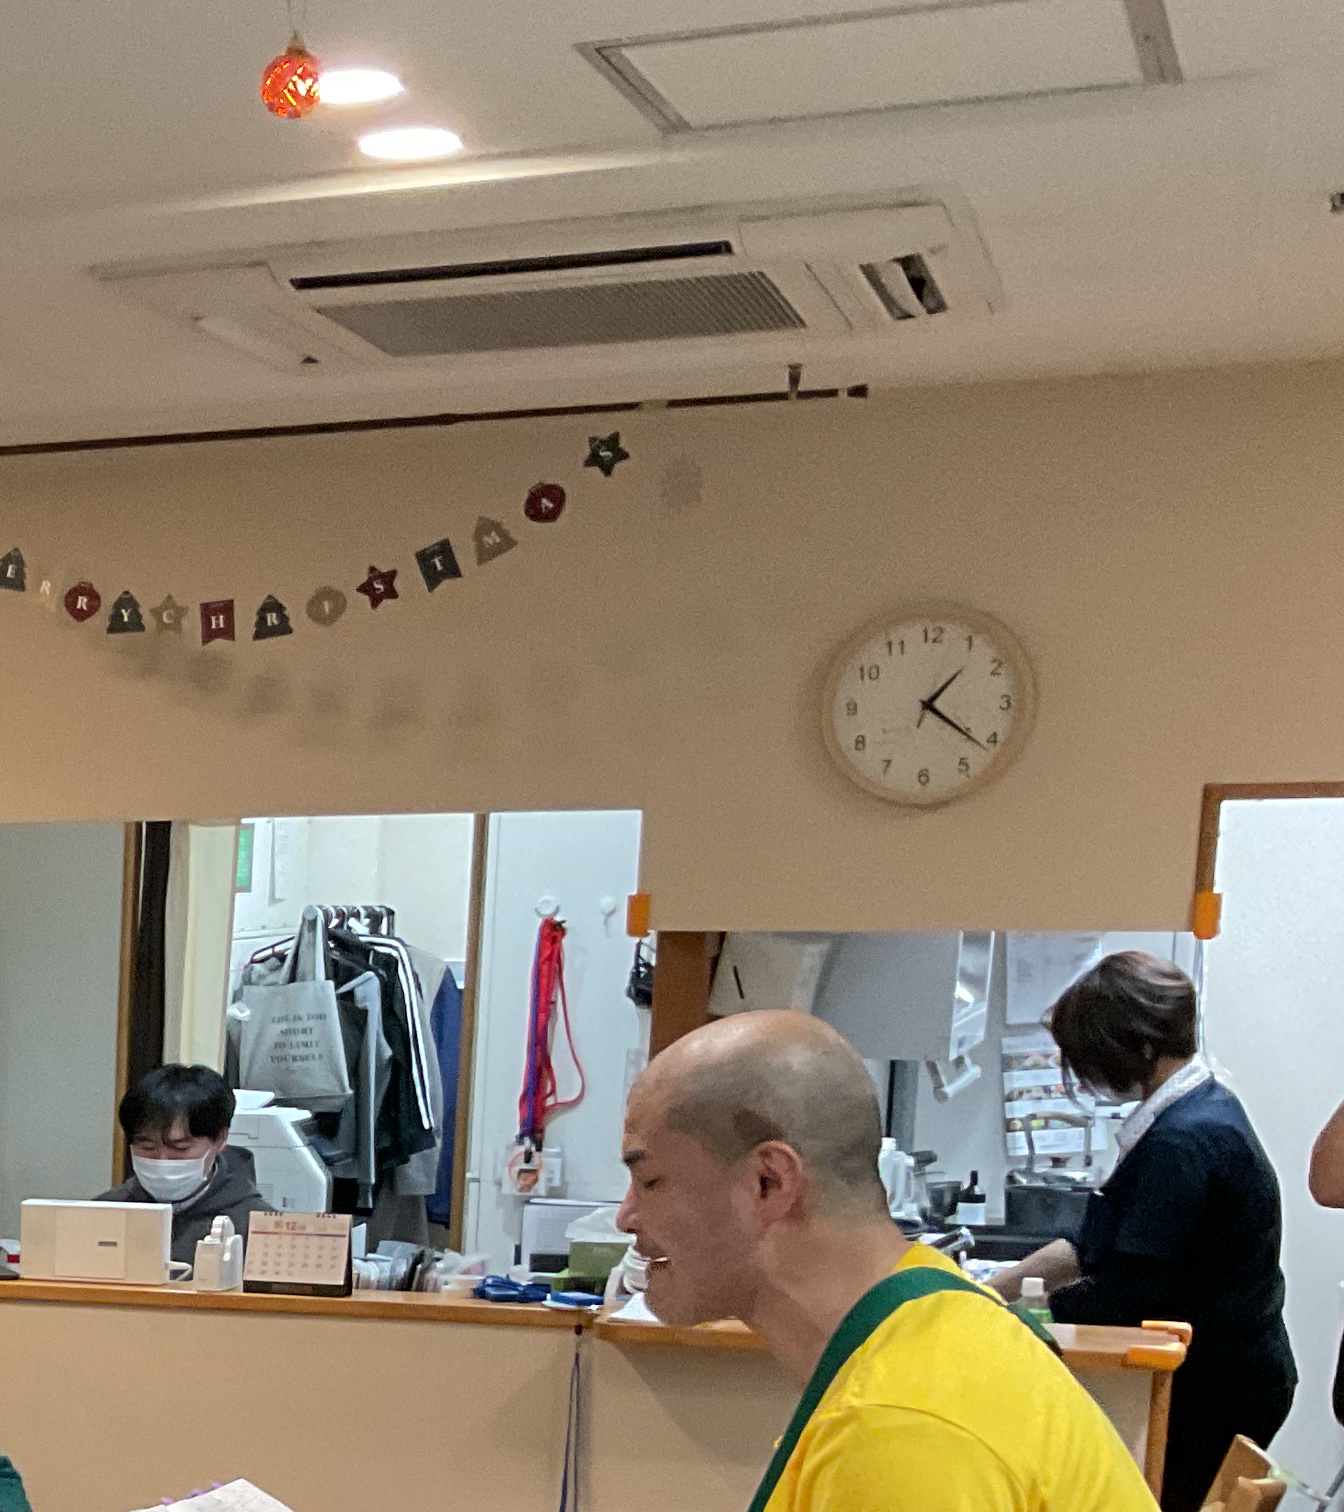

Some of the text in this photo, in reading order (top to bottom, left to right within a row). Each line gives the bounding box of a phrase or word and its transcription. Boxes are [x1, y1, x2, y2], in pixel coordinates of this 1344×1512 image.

[922, 626, 945, 644] 12
[964, 635, 974, 651] 1
[886, 639, 905, 656] 11
[858, 663, 880, 682] 10
[989, 658, 1004, 677] 2
[845, 699, 858, 716] 9
[998, 693, 1012, 711] 3
[854, 734, 866, 751] 8
[986, 731, 999, 747] 4
[881, 758, 893, 775] 7
[957, 757, 971, 773] 5
[917, 768, 930, 786] 6
